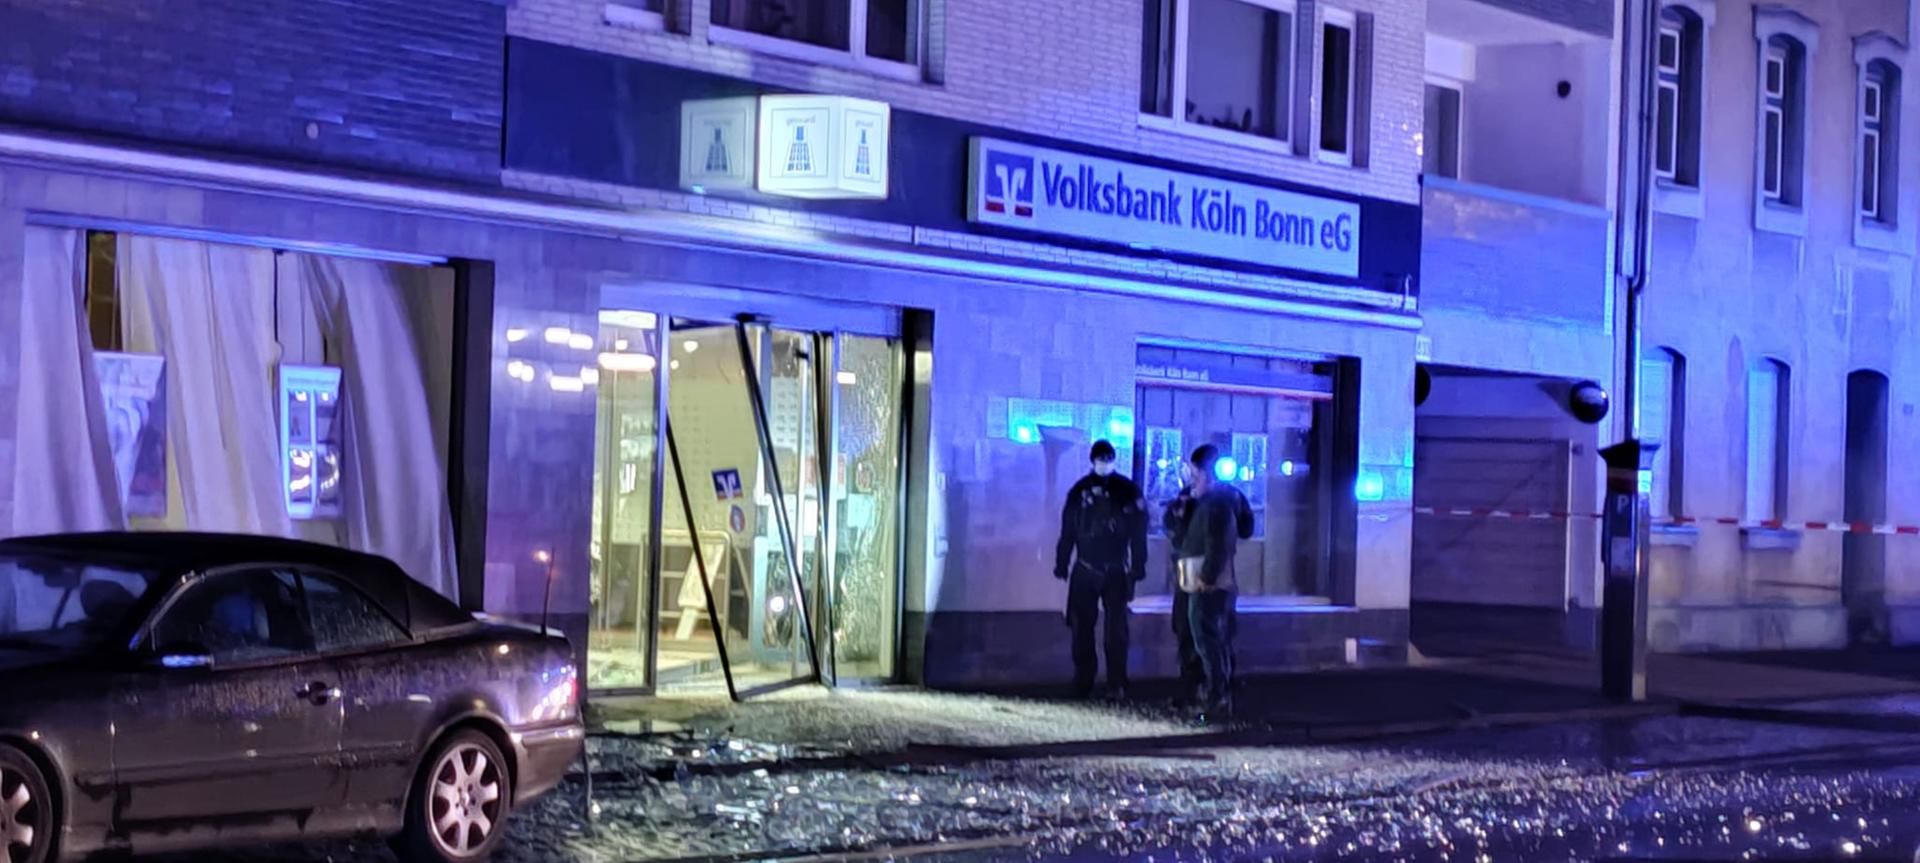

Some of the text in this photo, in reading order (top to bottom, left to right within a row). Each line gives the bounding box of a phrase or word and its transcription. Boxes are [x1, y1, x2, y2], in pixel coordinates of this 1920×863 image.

[1042, 162, 1351, 252] Volksbank Köln Bonn eG
[1617, 494, 1629, 513] P
